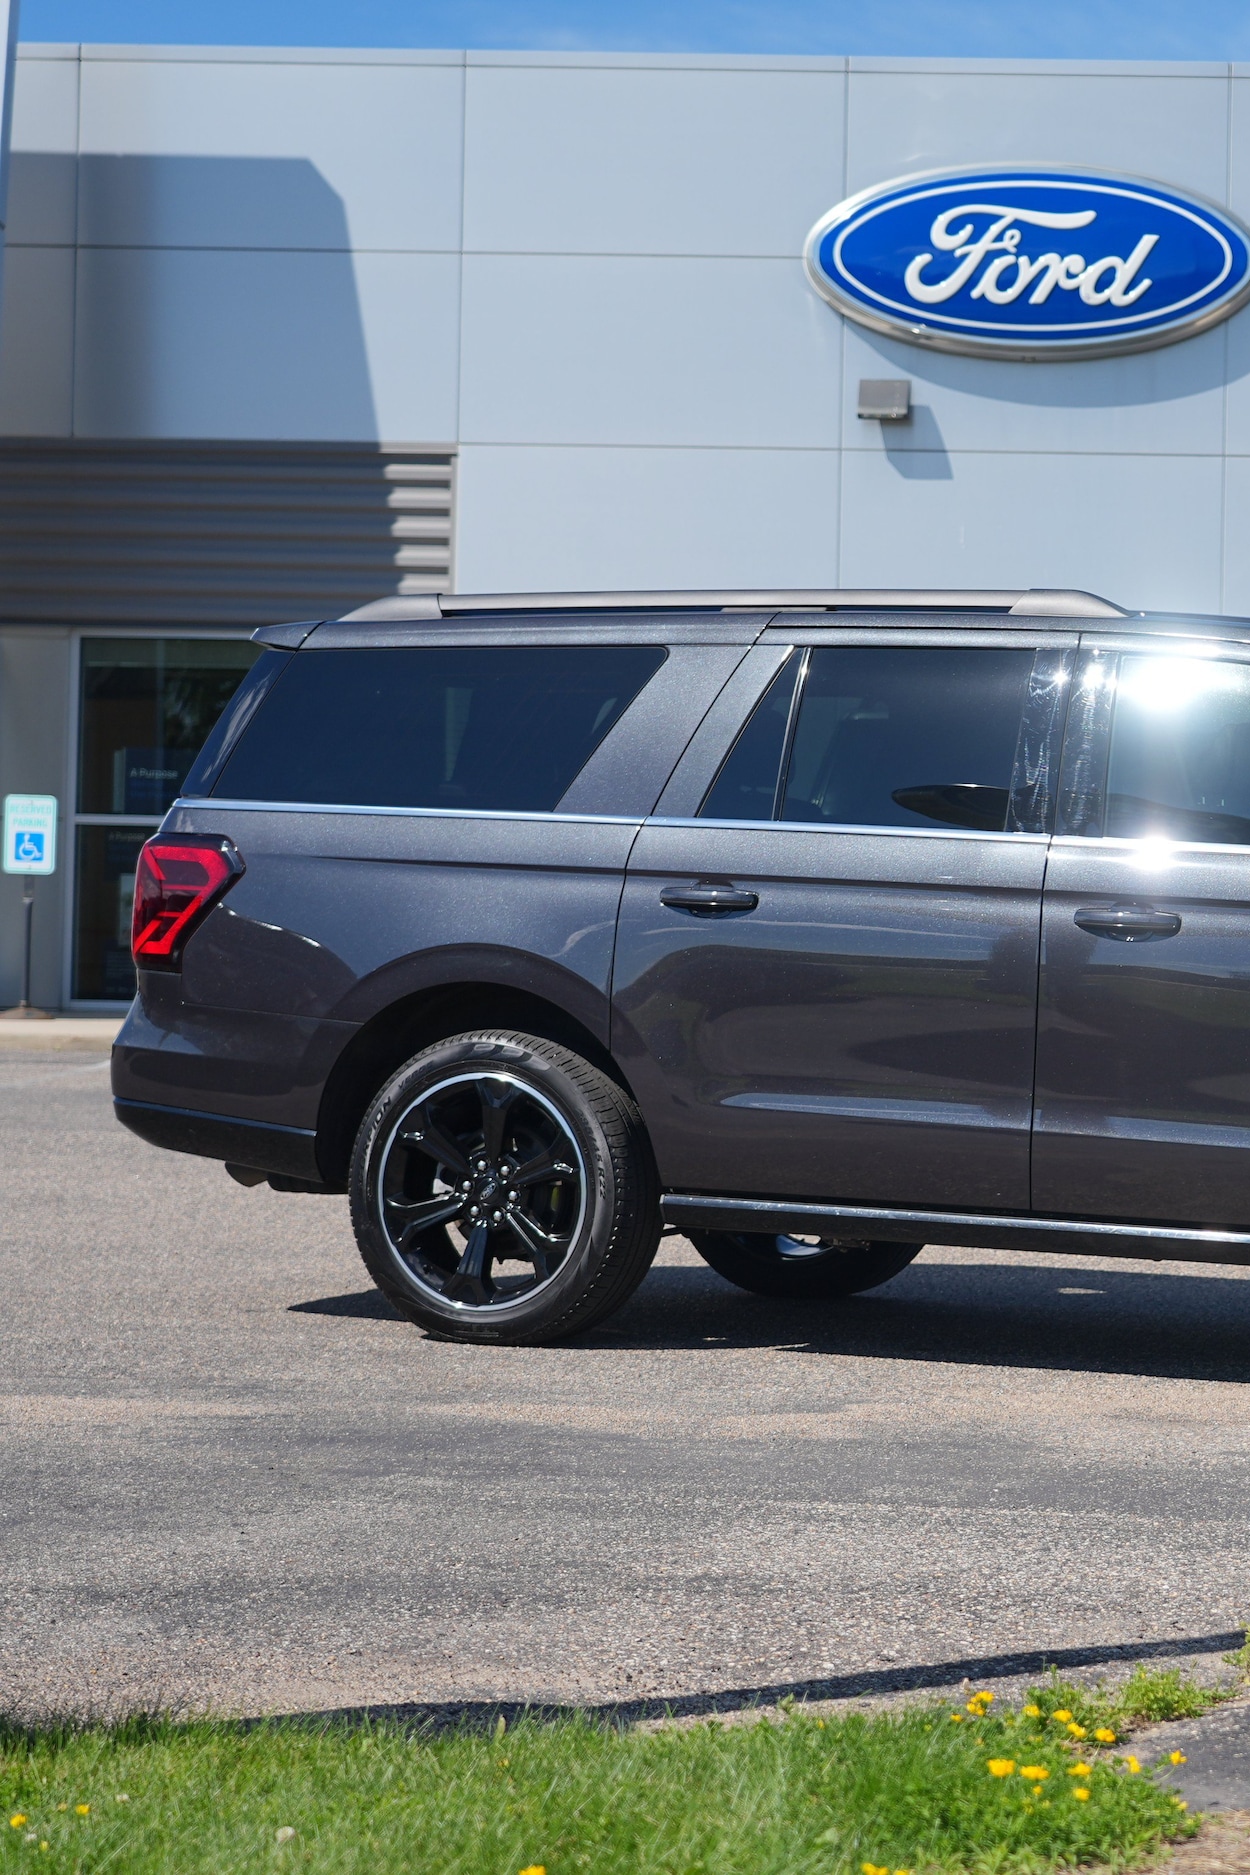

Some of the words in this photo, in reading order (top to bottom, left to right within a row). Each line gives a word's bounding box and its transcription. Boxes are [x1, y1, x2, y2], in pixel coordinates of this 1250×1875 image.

[904, 204, 1160, 307] Ford
[130, 767, 137, 777] A
[139, 768, 178, 780] Purpose
[10, 805, 52, 814] RESERVED
[14, 818, 48, 827] PARKING
